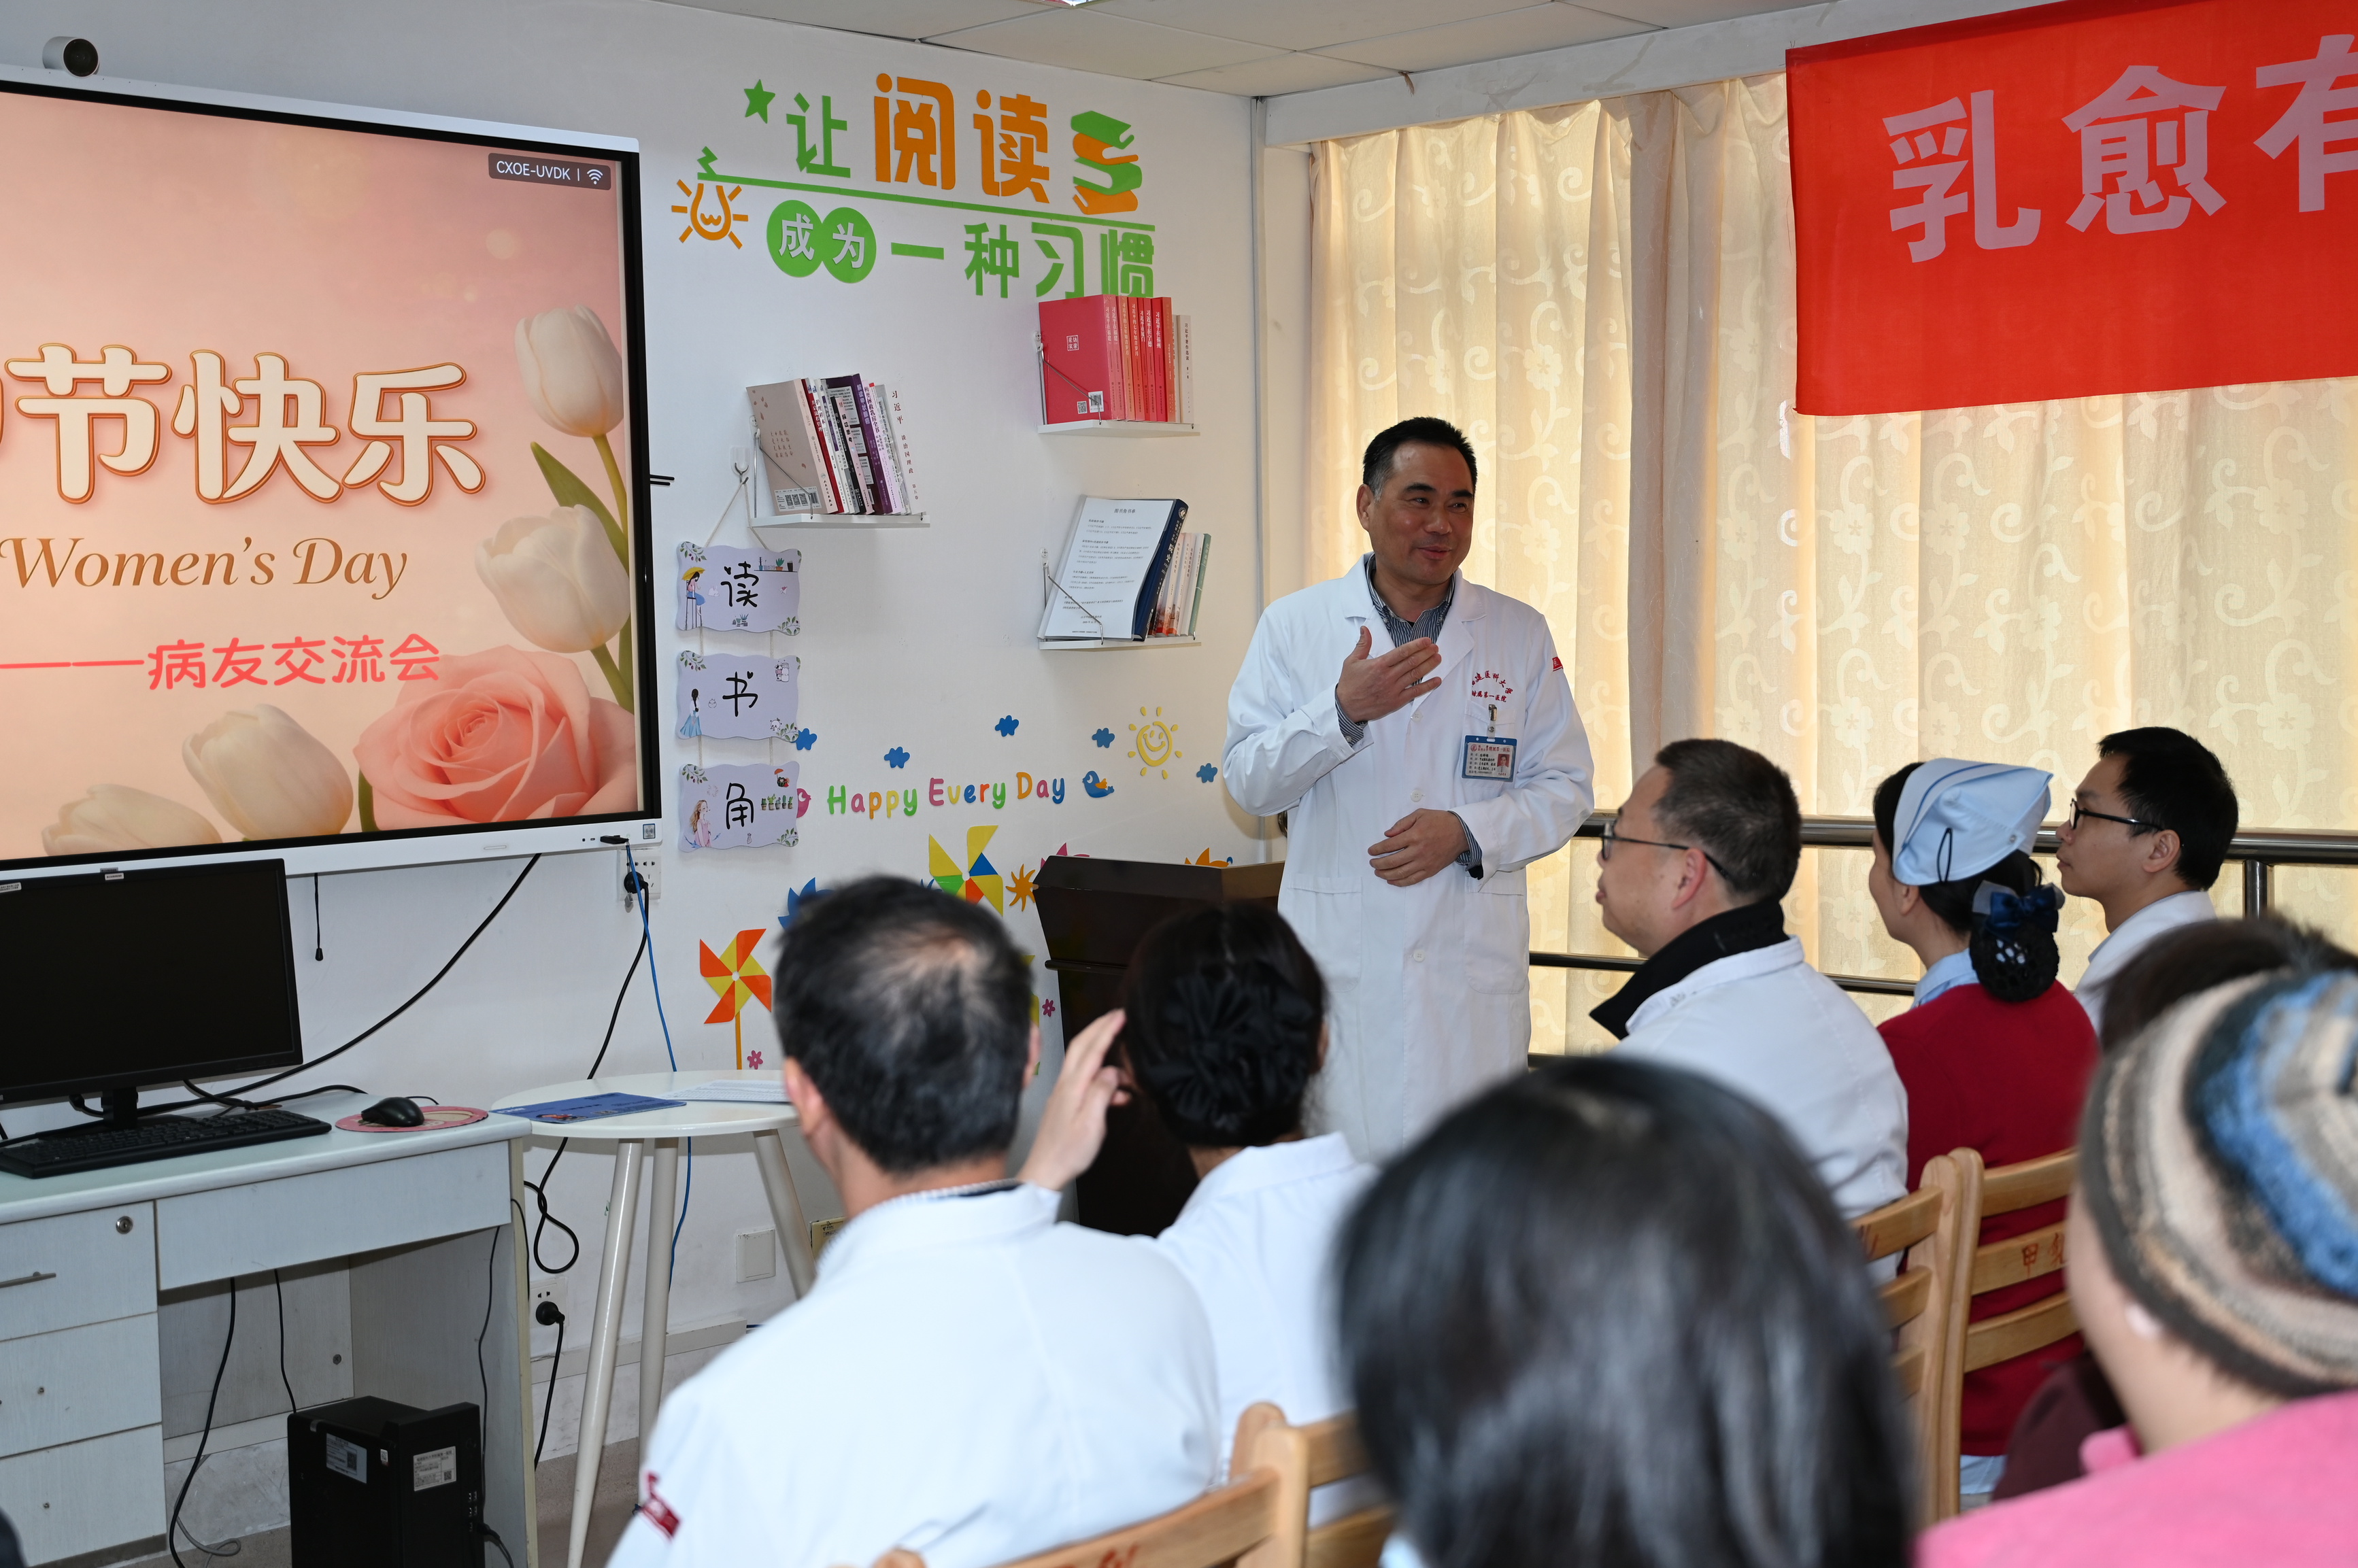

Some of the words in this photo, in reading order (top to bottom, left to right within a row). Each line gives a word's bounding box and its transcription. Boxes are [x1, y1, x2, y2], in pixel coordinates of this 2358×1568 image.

[786, 72, 1051, 204] 让阅读
[1883, 33, 2358, 263] 乳愈有
[496, 160, 571, 182] CXOE-UVDK
[778, 213, 1155, 299] 成为一种习惯
[0, 343, 487, 508] 节快乐
[856, 384, 871, 425] 解读甲状腺癌
[892, 390, 904, 425] 习近平
[0, 536, 276, 588] Women's
[293, 536, 409, 600] Day
[1165, 543, 1175, 563] 院史
[720, 561, 760, 608] 读
[722, 670, 759, 719] 书
[726, 783, 754, 830] 角
[826, 784, 918, 820] Happy
[929, 777, 1007, 810] Every
[1017, 772, 1066, 804] Day
